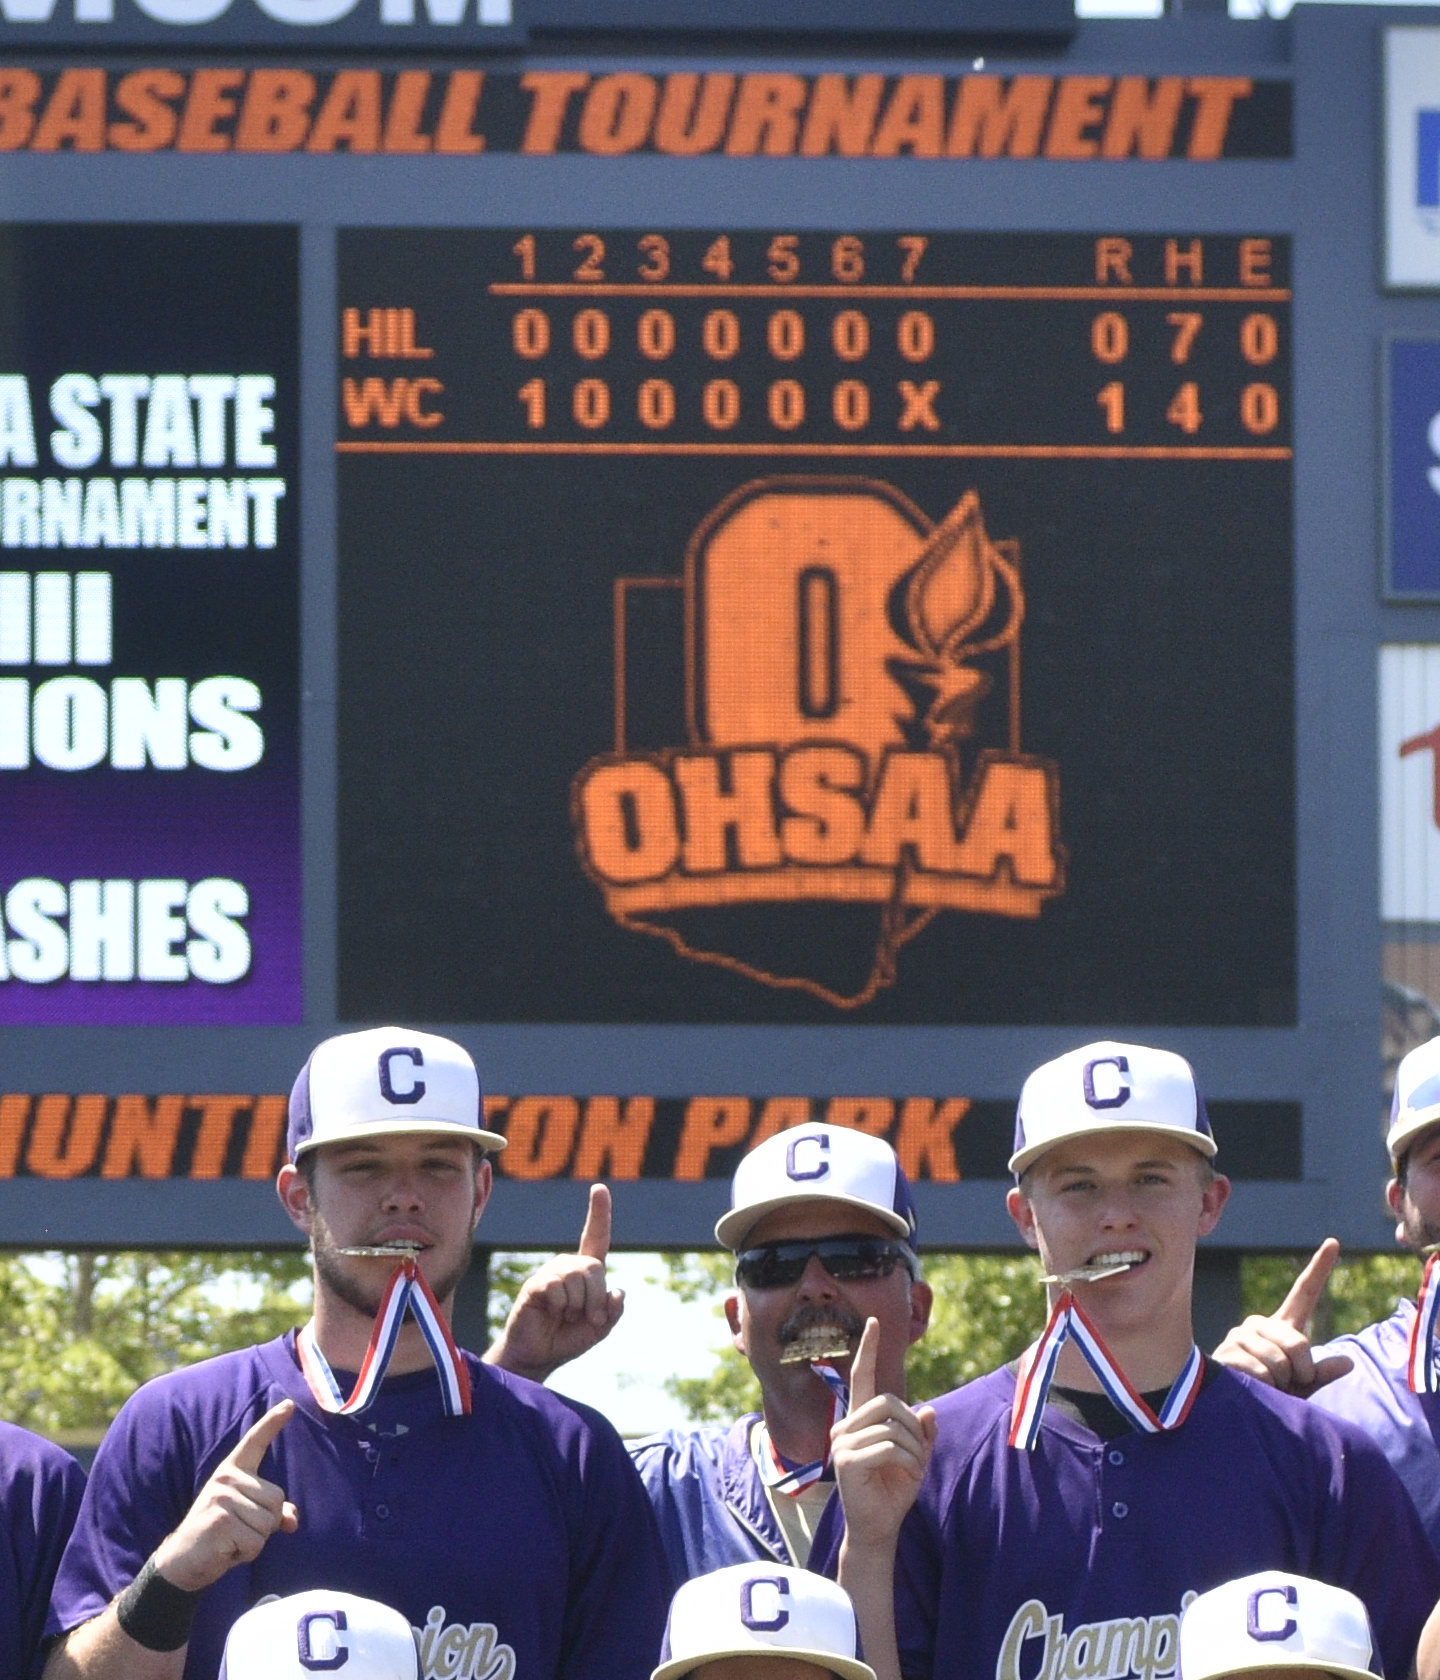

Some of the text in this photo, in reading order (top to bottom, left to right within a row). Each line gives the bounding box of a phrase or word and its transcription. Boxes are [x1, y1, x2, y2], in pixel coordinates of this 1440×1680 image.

[521, 71, 1251, 161] TOURNAMENT
[515, 234, 1269, 287] 1 2 3 4 5 6 7 R H E
[343, 307, 1278, 365] HIL 0 0 0 0 0 0 0 0 7 0
[50, 373, 277, 468] STATE
[343, 377, 1279, 434] WC 1 0 0 0 0 0 X 1 4 0
[579, 742, 1059, 886] OHSAA
[378, 1046, 426, 1105] C
[1083, 1056, 1130, 1109] C
[786, 1134, 829, 1181] C
[740, 1576, 790, 1631] C
[1247, 1585, 1297, 1642] C
[297, 1610, 349, 1671] C
